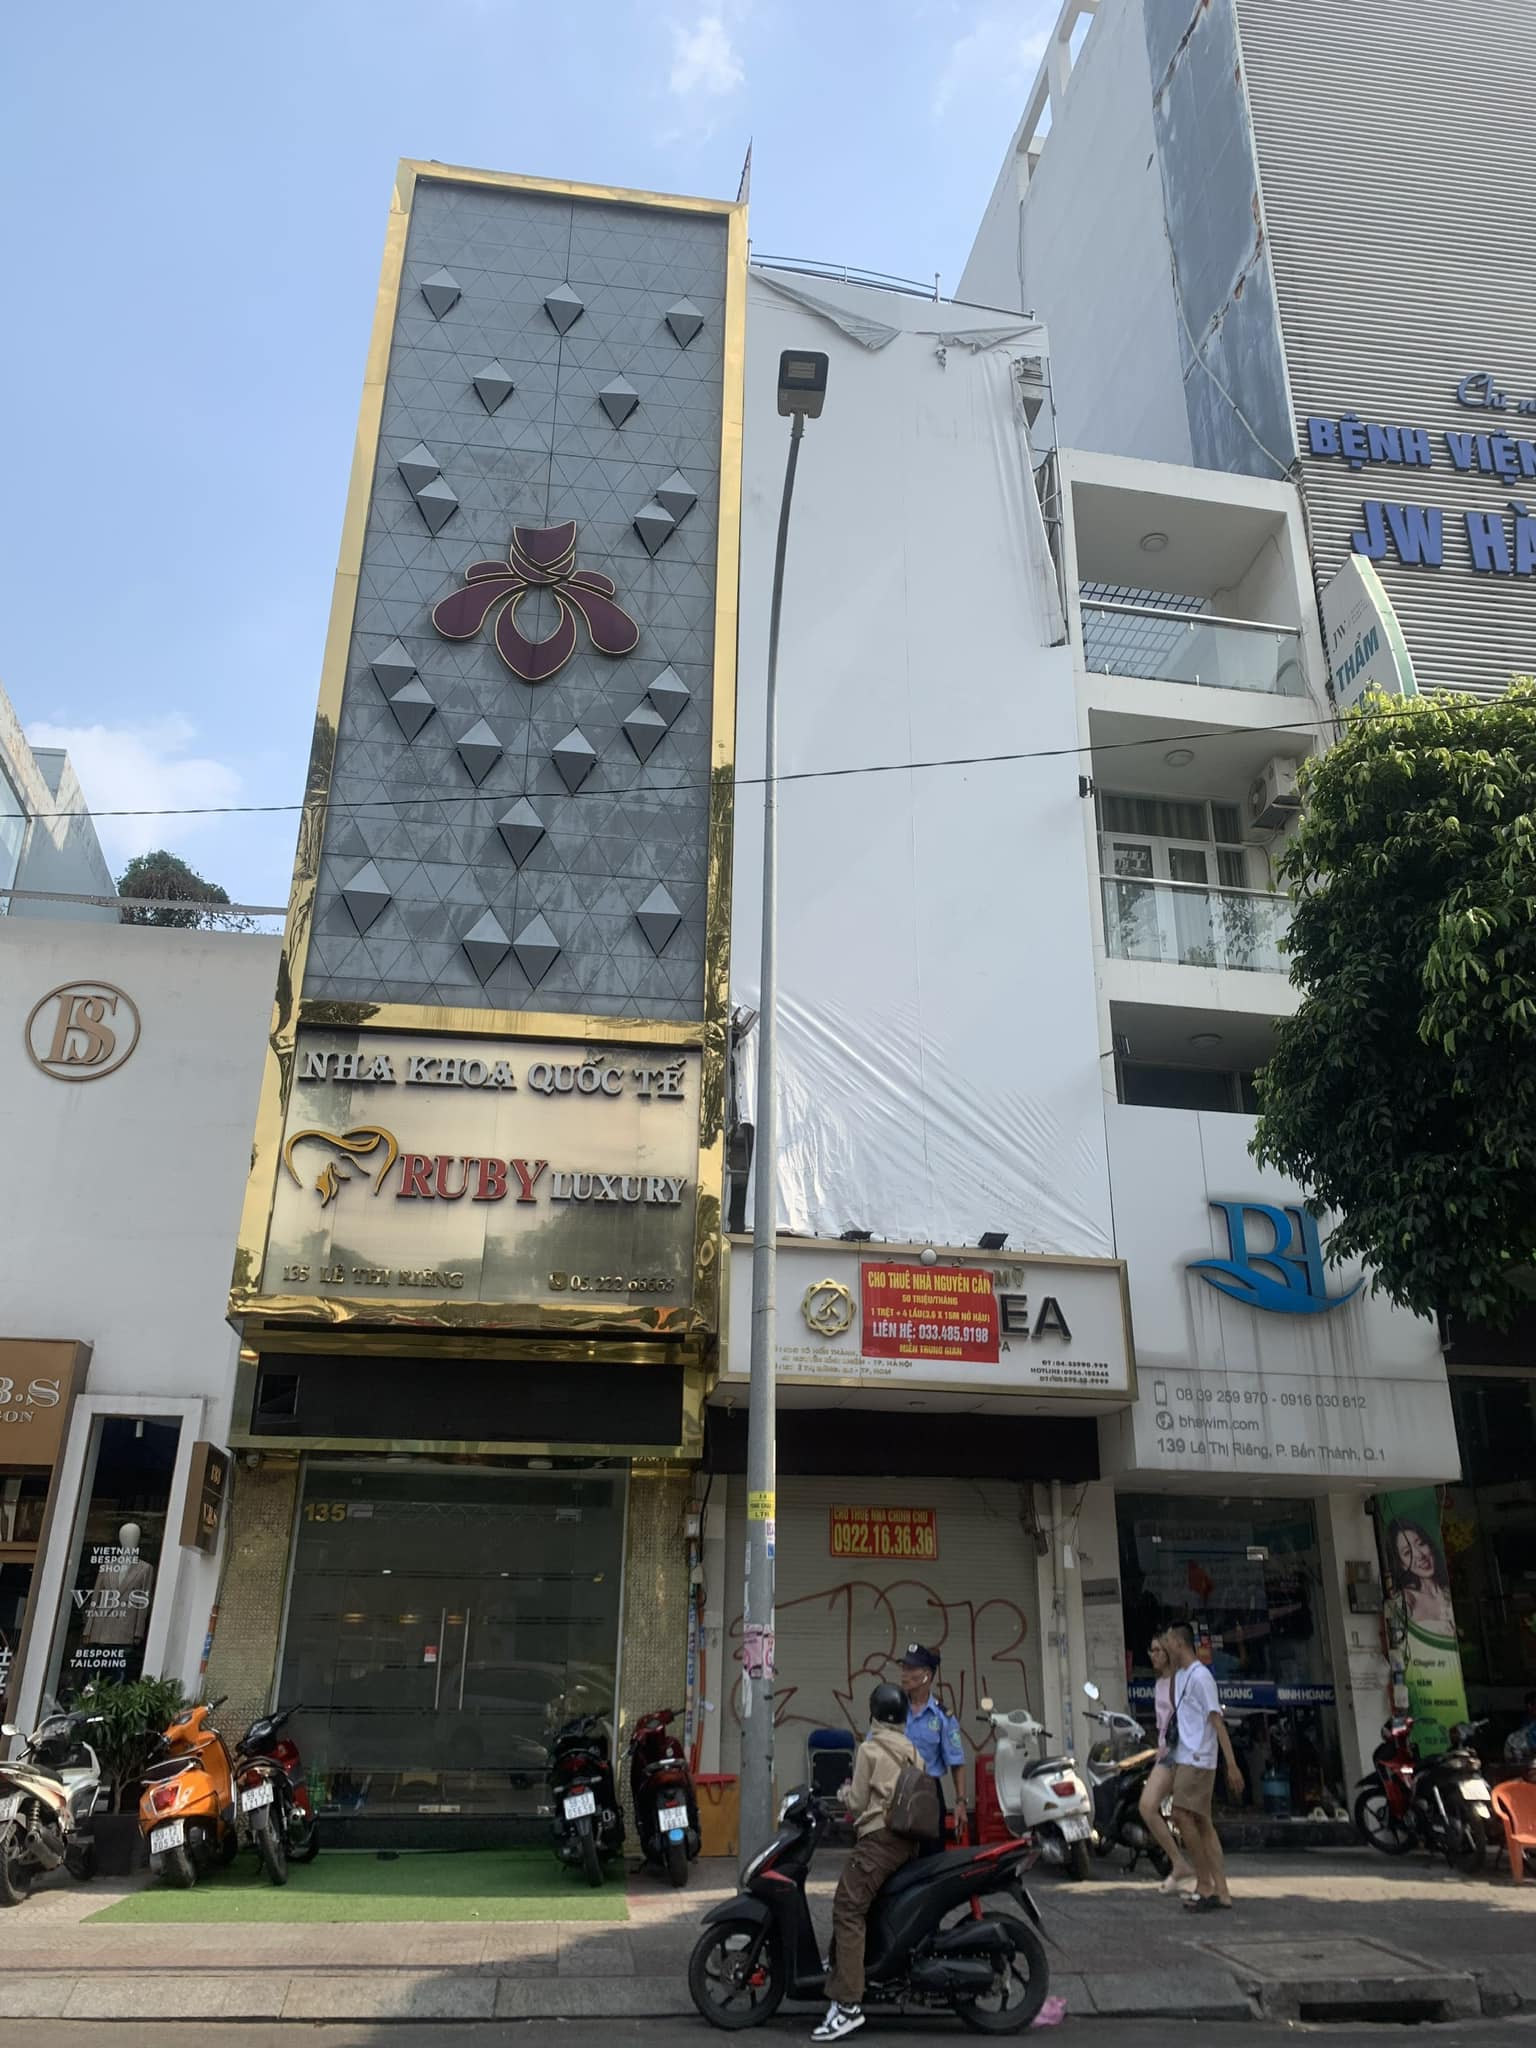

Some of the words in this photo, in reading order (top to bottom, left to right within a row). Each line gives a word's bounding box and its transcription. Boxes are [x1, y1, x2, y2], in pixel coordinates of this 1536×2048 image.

[1307, 412, 1433, 470] BỆNH
[1351, 501, 1443, 567] JW
[1335, 625, 1380, 693] THẨM
[298, 1051, 397, 1084] NHA
[405, 1055, 517, 1090] KHOA
[527, 1056, 625, 1097] QUỐC
[632, 1057, 688, 1099] TẾ
[397, 1153, 548, 1202] RUBY
[550, 1172, 688, 1204] LUXURY
[283, 1265, 310, 1282] 135
[352, 1267, 394, 1288] THỊ
[398, 1268, 465, 1289] RIÊNG
[868, 1271, 886, 1288] CHO
[888, 1270, 911, 1290] THUÊ
[912, 1271, 931, 1291] NHÀ
[934, 1273, 969, 1292] NGUYÊN
[972, 1275, 991, 1295] CĂN
[902, 1294, 912, 1302] 50
[873, 1320, 897, 1338] LIÊN
[899, 1320, 916, 1342] HỆ:
[919, 1324, 989, 1343] 033.485.9198
[920, 1344, 943, 1355] TRUNG
[944, 1345, 962, 1356] GIAN
[1176, 1388, 1193, 1402] 08
[1217, 1390, 1241, 1404] 259
[1244, 1391, 1268, 1406] 970
[1280, 1393, 1312, 1408] 0916
[1315, 1394, 1339, 1409] 030
[1178, 1415, 1260, 1432] bhswim.com
[1157, 1437, 1186, 1453] 139
[1190, 1439, 1206, 1454] Lê
[1208, 1441, 1229, 1457] Thị
[1232, 1440, 1272, 1460] Riêng,
[1276, 1443, 1287, 1457] P.
[1291, 1441, 1316, 1458] Bến
[1318, 1443, 1361, 1461] Thành,
[1364, 1447, 1385, 1461] Q.1
[304, 1503, 348, 1522] 135
[834, 1523, 933, 1555] 0922.16.36.36
[90, 1555, 139, 1564] BESPOKE
[93, 1547, 140, 1555] VIETNAM
[99, 1564, 128, 1573] SHOP
[70, 1589, 149, 1609] V.B.S
[85, 1609, 127, 1618] TAILOR
[70, 1659, 126, 1668] TAILORING
[75, 1649, 124, 1658] BESPOKE
